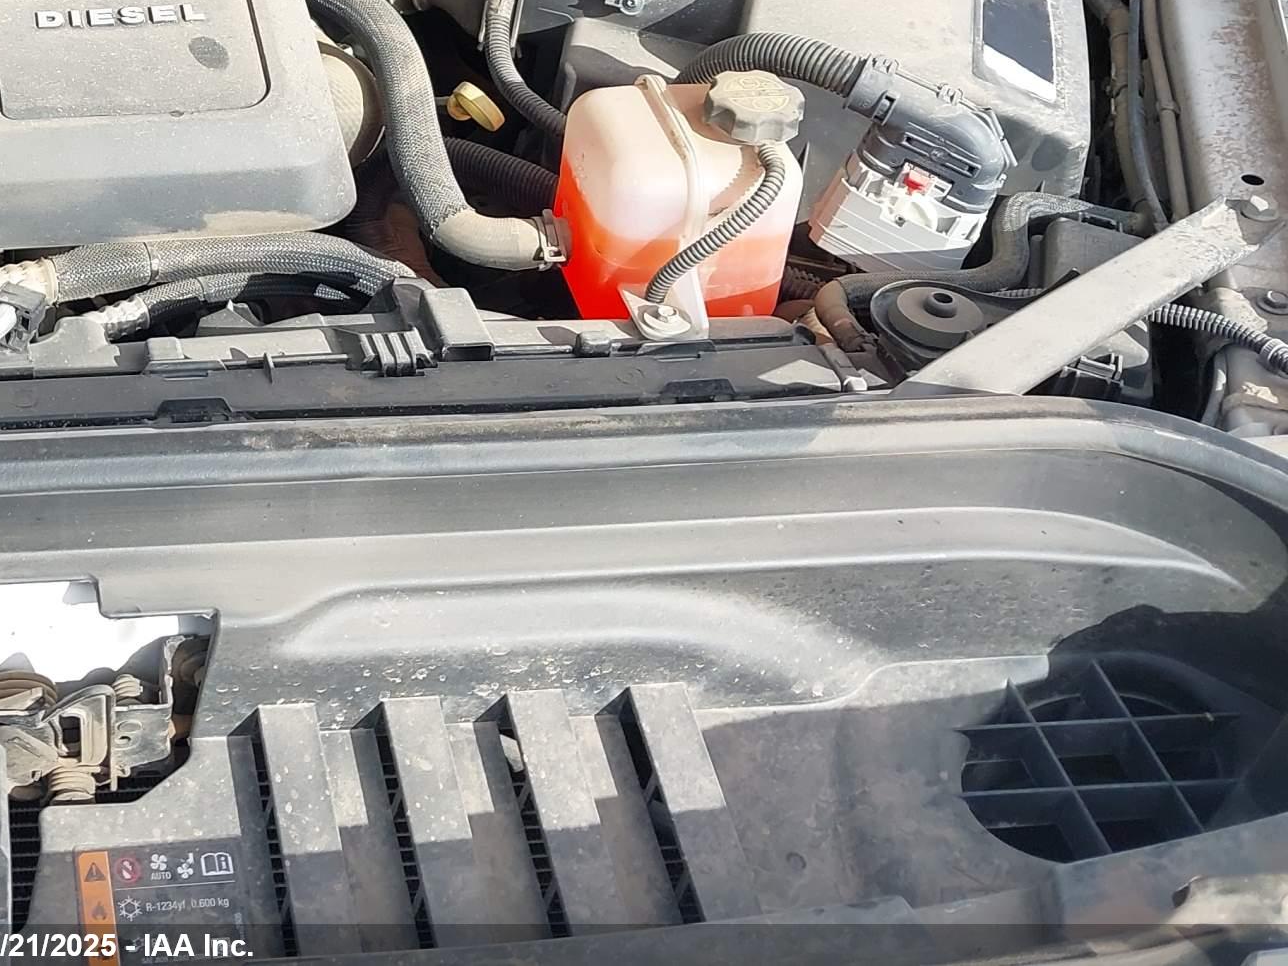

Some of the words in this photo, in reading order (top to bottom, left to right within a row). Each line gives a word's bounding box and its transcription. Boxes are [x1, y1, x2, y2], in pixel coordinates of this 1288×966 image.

[34, 4, 205, 29] DIESEL
[151, 871, 172, 881] AUTO
[145, 899, 186, 912] R-1234yf
[191, 897, 216, 908] 0.600
[217, 897, 230, 908] kg
